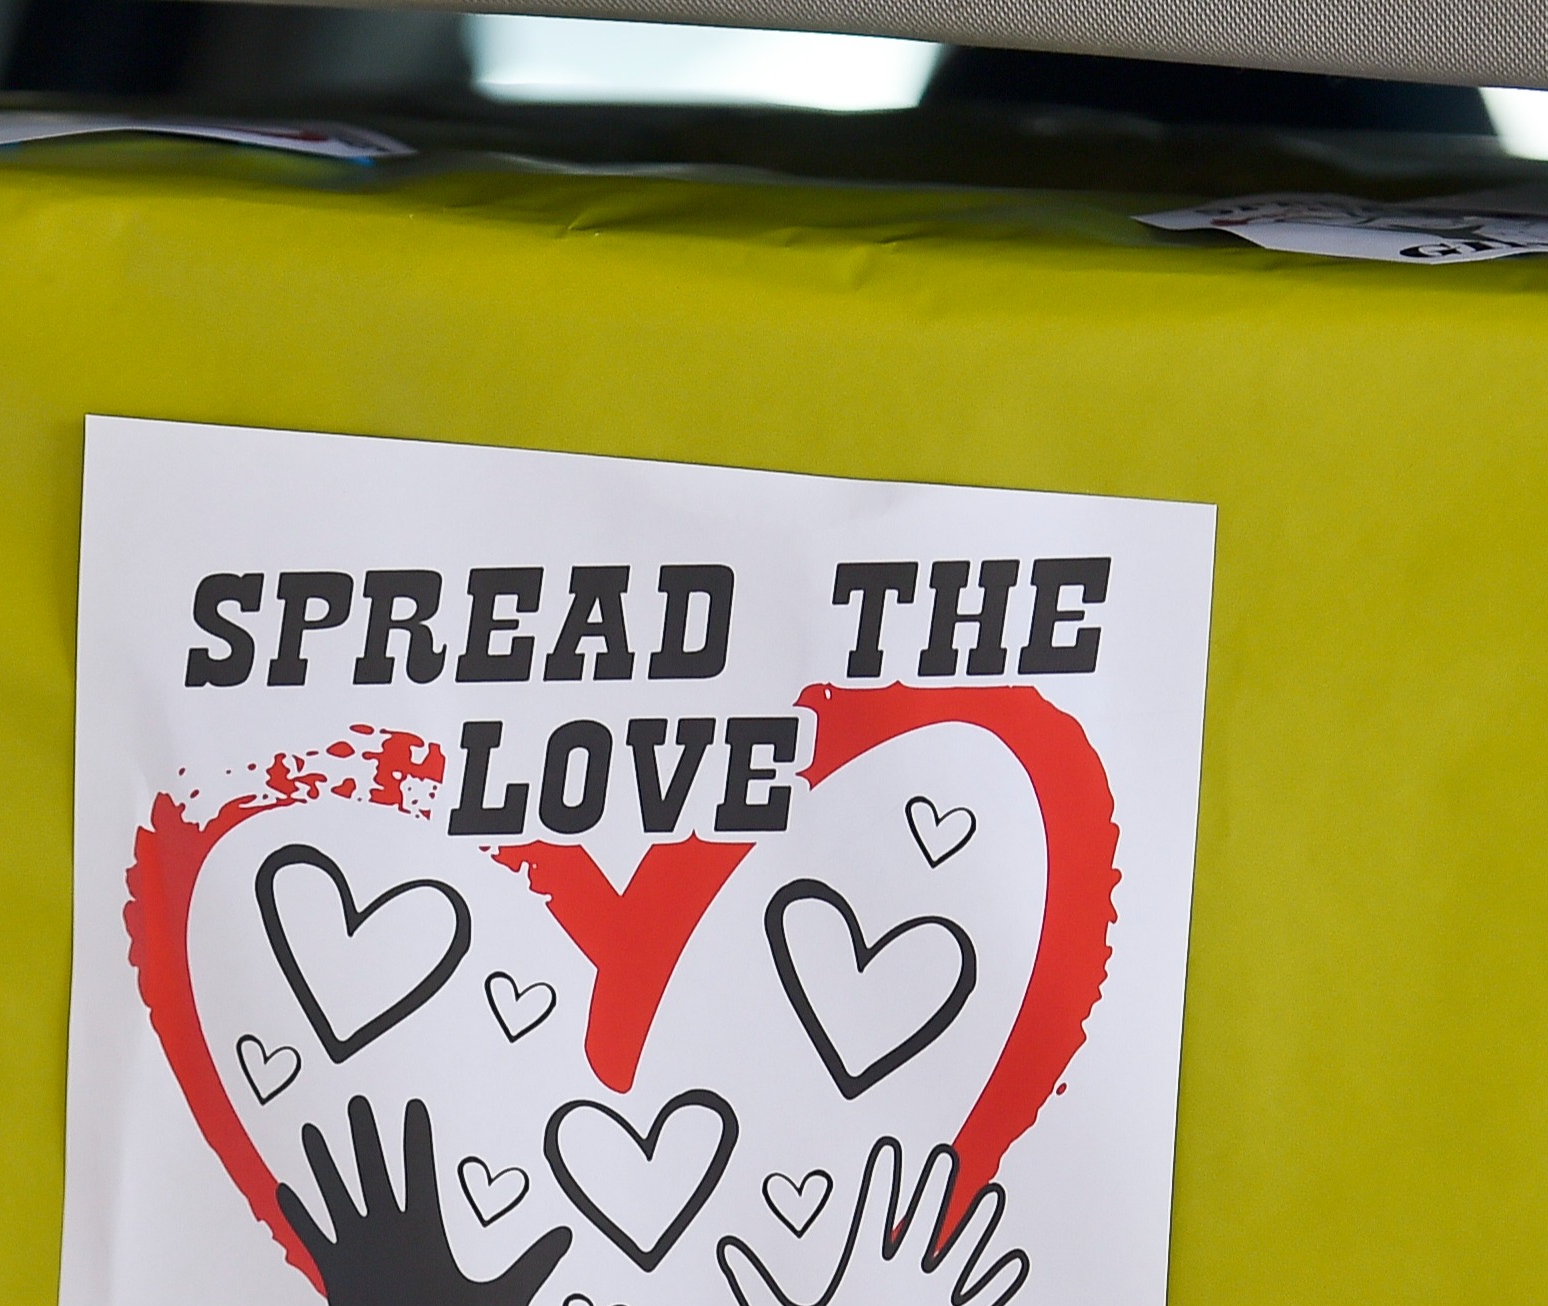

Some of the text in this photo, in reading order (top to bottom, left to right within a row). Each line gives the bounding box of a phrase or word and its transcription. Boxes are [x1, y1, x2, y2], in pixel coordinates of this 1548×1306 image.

[183, 556, 1112, 688] SPREAD THE
[447, 716, 799, 835] LOVE
